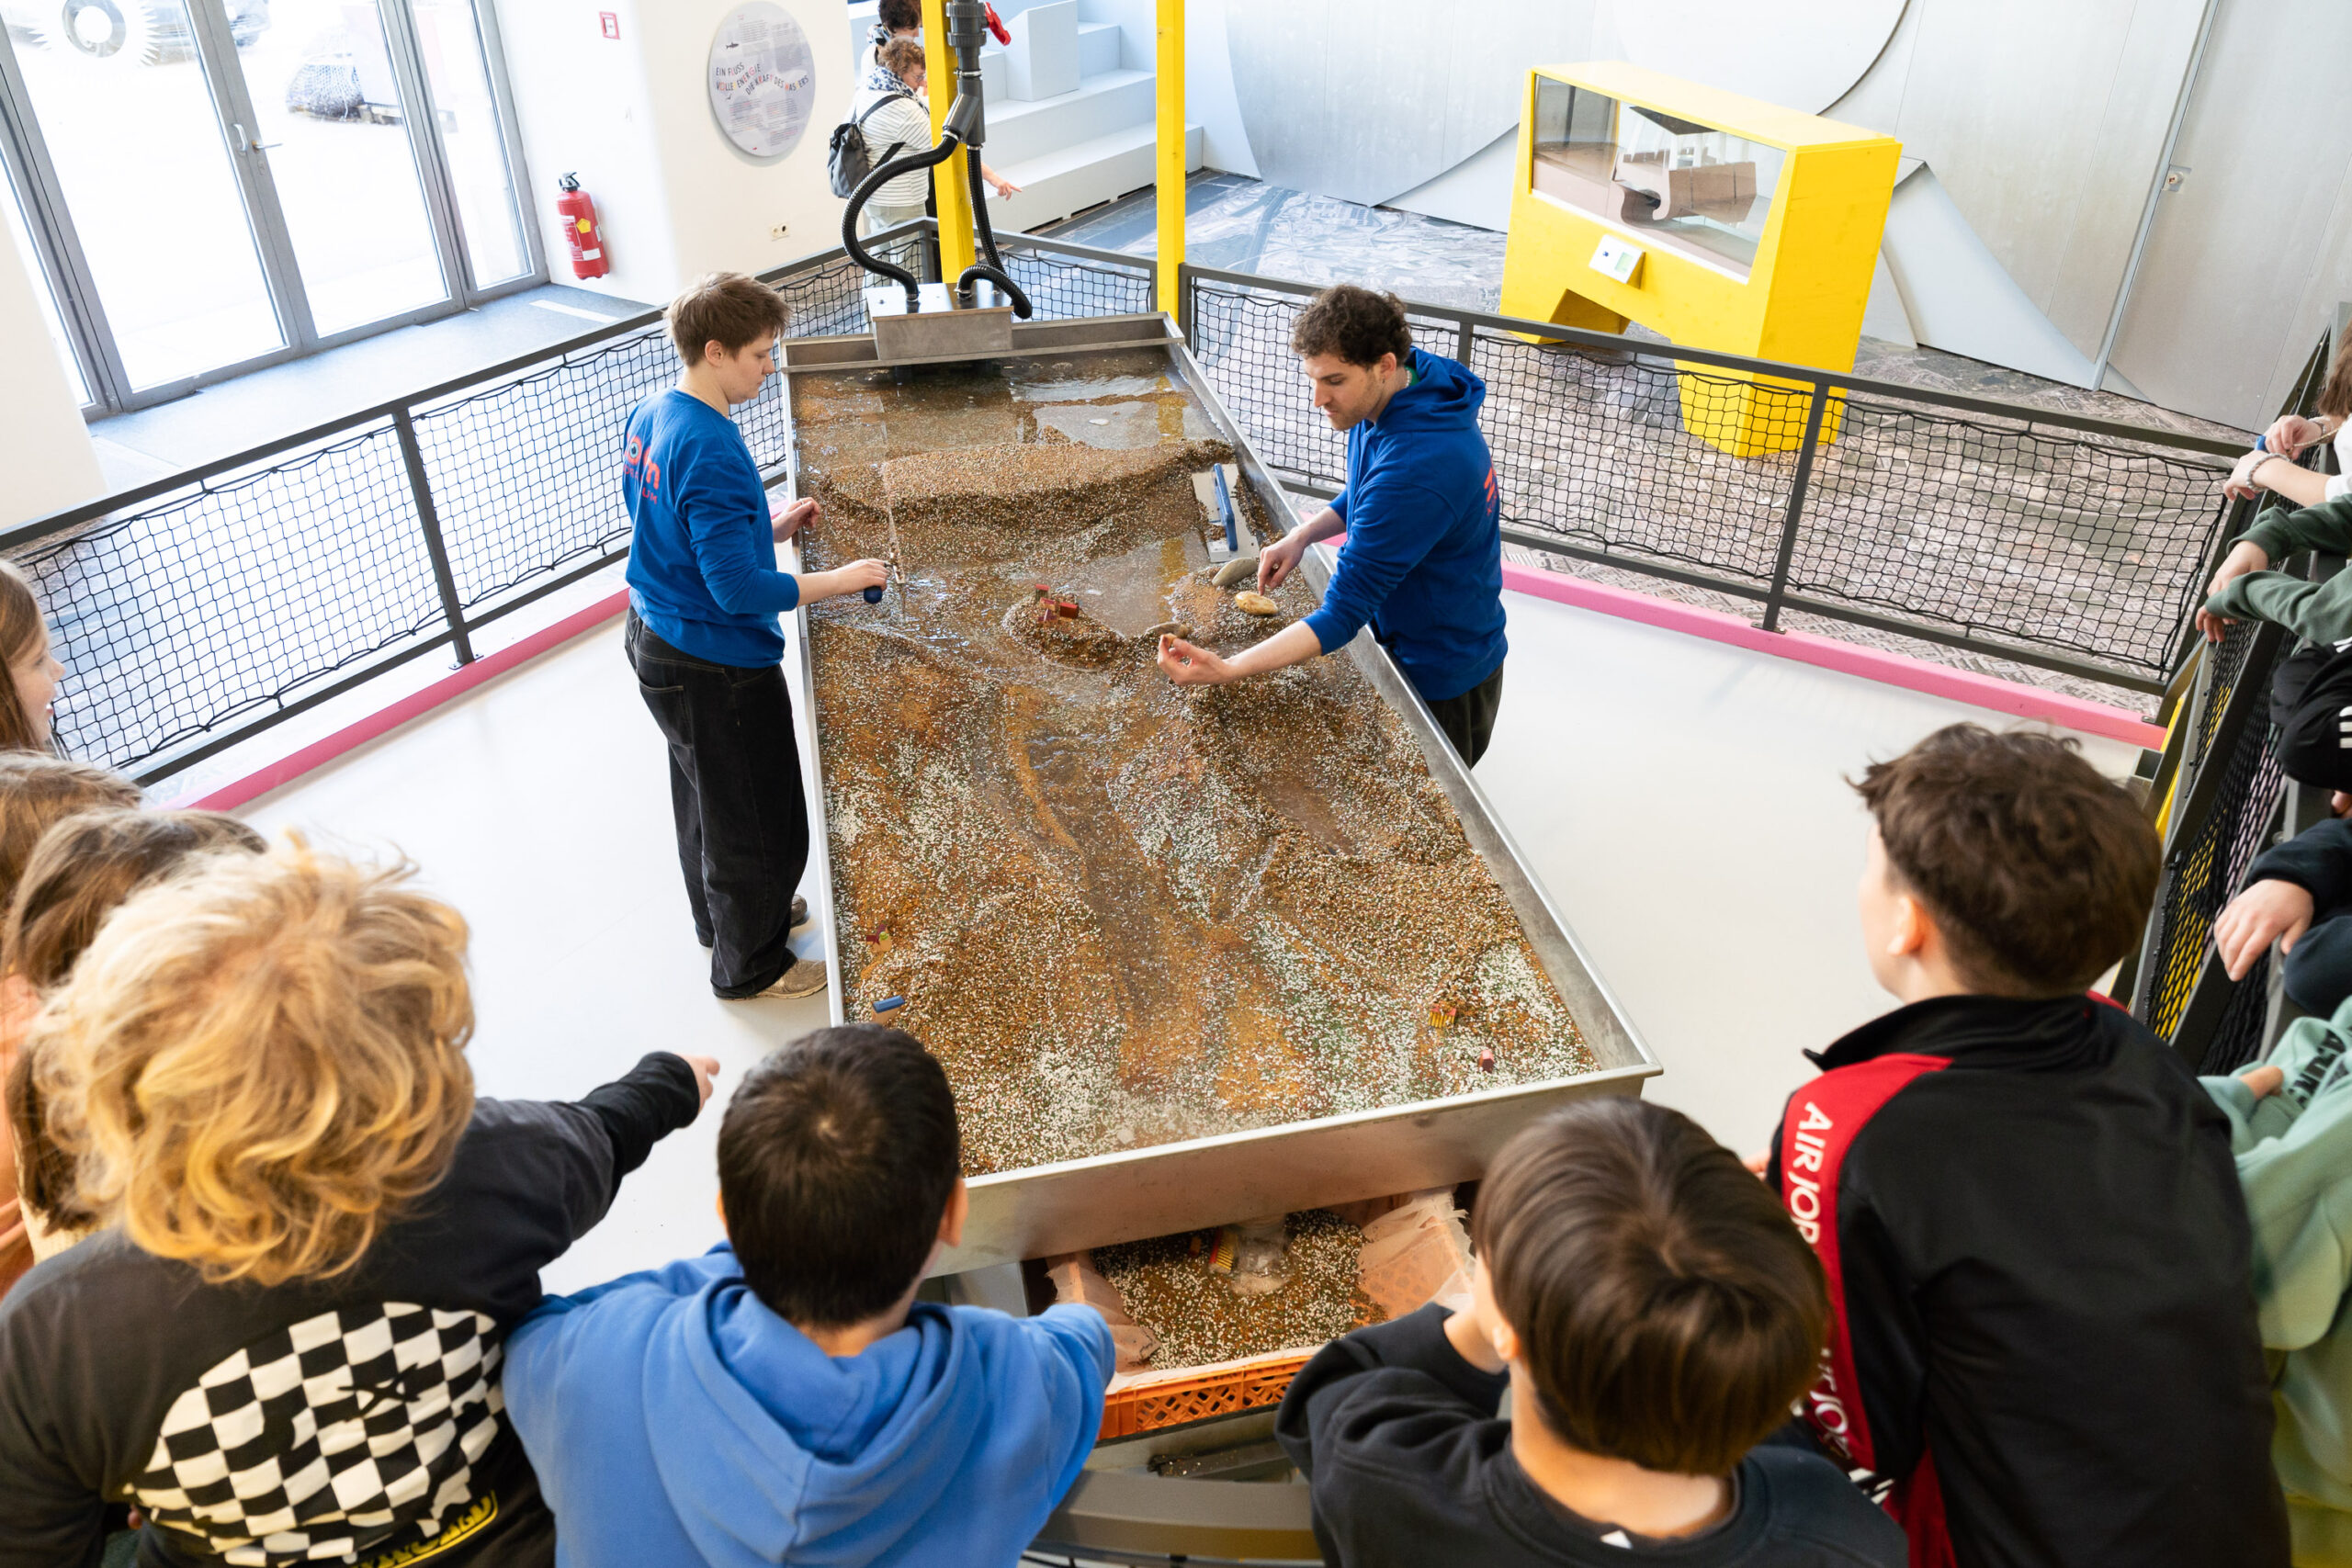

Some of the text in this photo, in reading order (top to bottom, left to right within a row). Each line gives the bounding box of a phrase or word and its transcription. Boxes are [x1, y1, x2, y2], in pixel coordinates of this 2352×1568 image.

[716, 62, 745, 76] EIN FLUSS
[737, 63, 762, 88] ENERGIE
[745, 73, 808, 96] DIE KRAFT DES WASSERS
[1792, 1101, 1834, 1173] AIR
